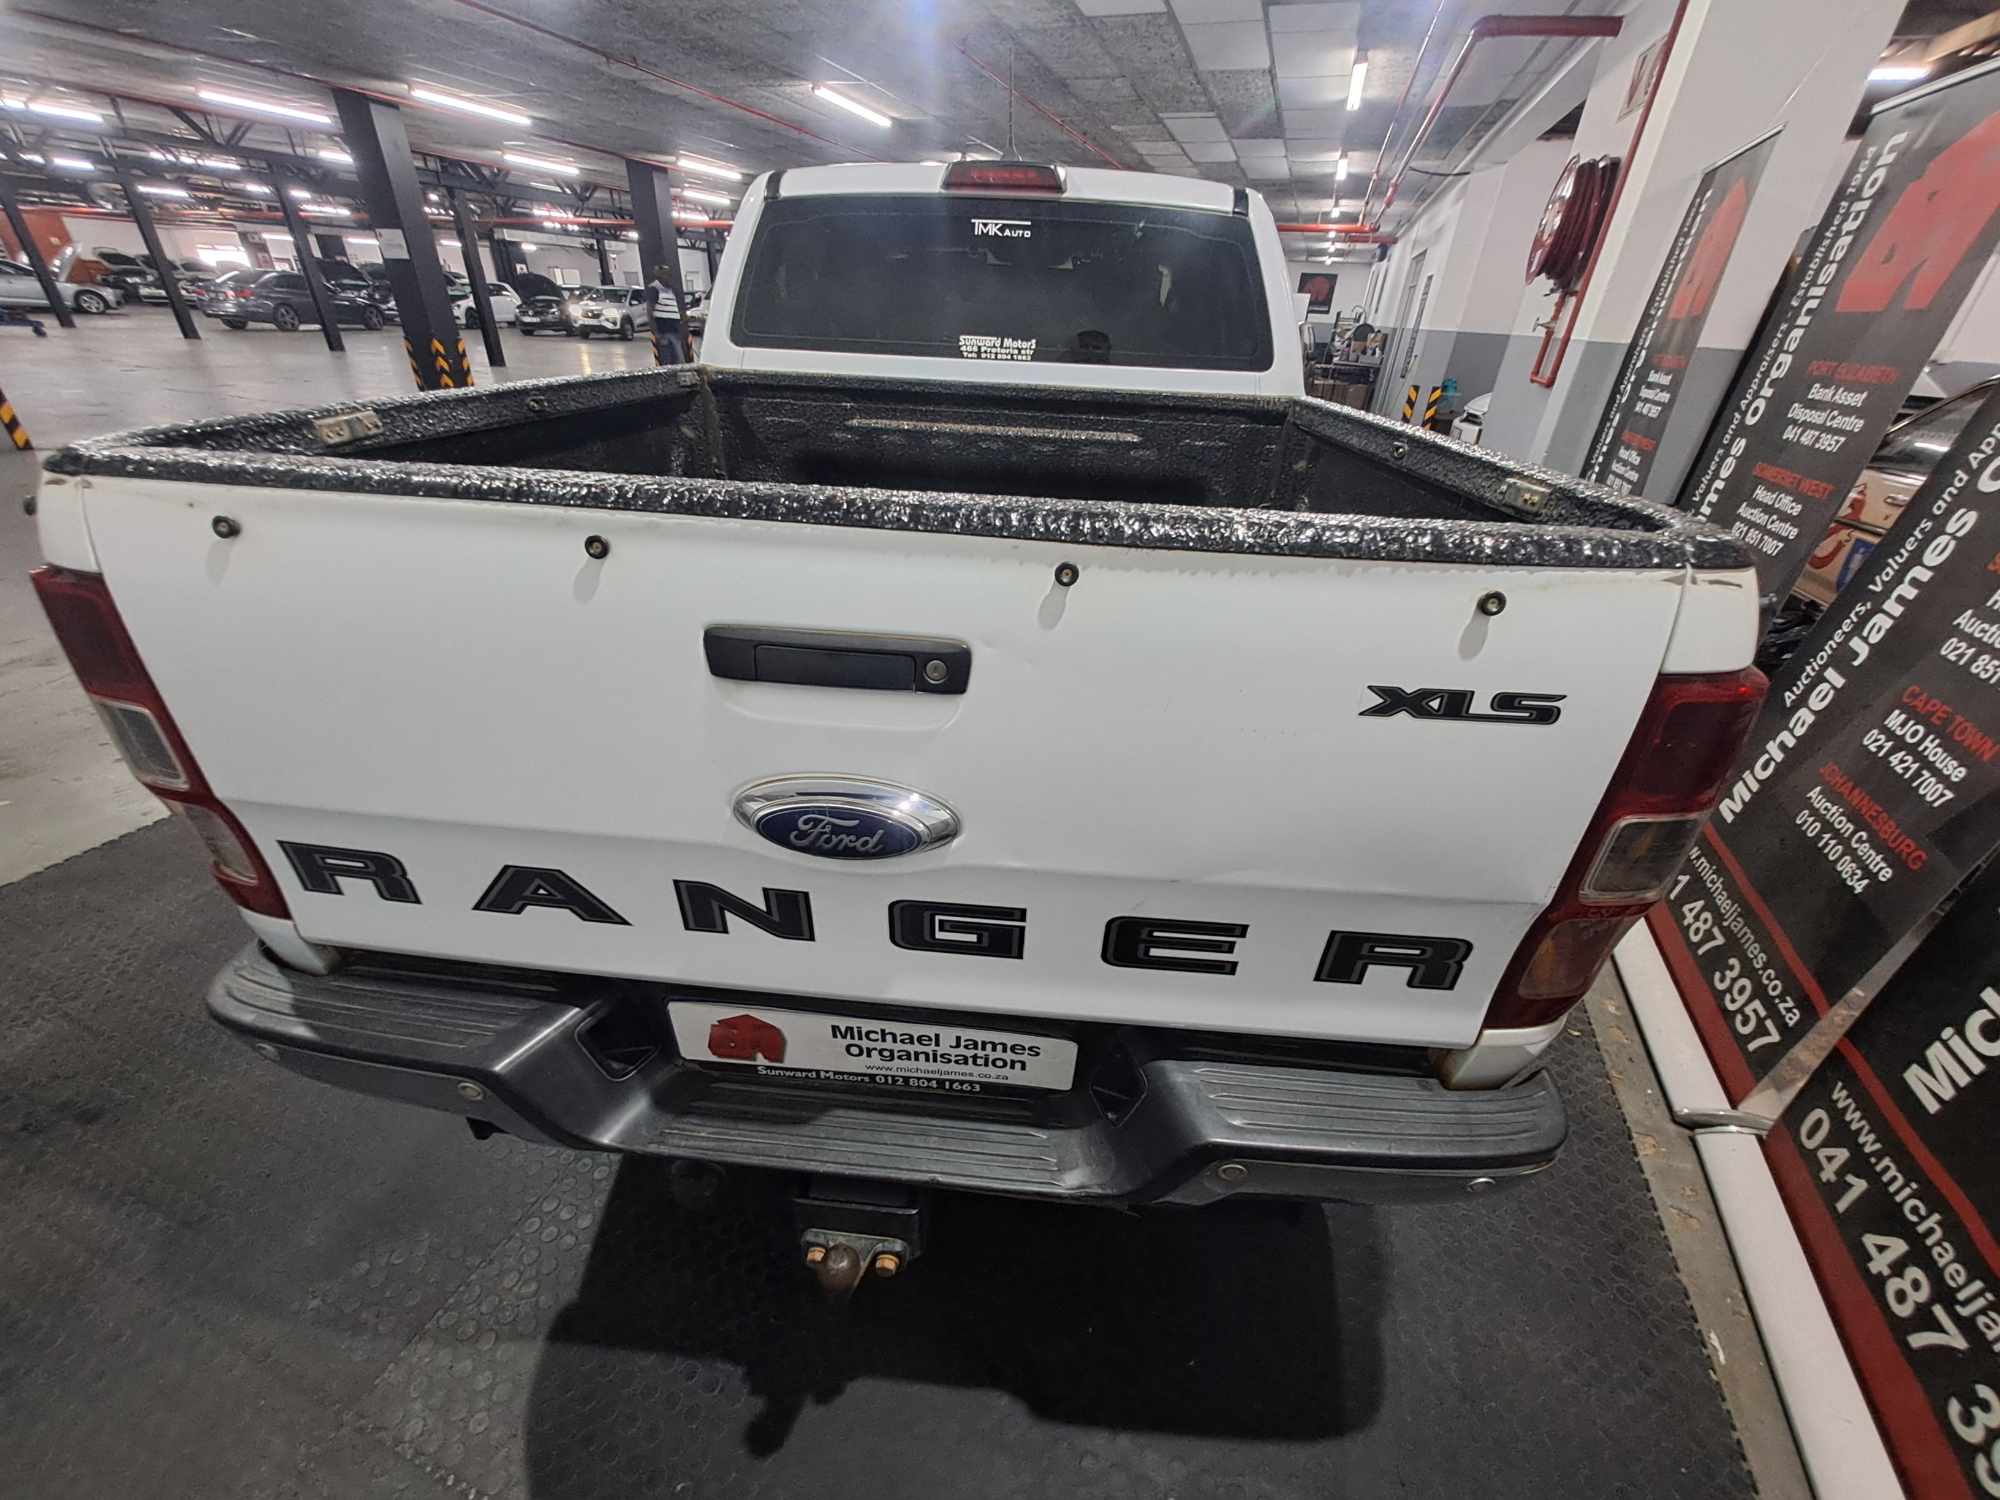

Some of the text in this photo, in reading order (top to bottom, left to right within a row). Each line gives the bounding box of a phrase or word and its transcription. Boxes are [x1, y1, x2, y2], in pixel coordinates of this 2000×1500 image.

[971, 219, 1031, 238] TMK AUTO
[1745, 131, 1910, 426] Organisation
[959, 335, 1037, 349] Sunward Motors
[1692, 448, 1723, 502] Valuers
[1723, 412, 1741, 444] and
[1740, 323, 1789, 411] Appraisers
[1807, 383, 1868, 408] Bank Asset
[1787, 402, 1864, 433] Disposal Centre
[1814, 432, 1847, 453] 3957
[1736, 502, 1800, 539] Auction Centre
[1752, 485, 1803, 516] Head Office
[1758, 535, 1784, 557] 7007
[1783, 600, 1872, 707] Auctioneers,
[1868, 518, 1933, 593] Valuers
[1932, 469, 1970, 515] and
[1718, 508, 1979, 824] Michael James
[1940, 637, 1976, 666] 021
[1358, 685, 1568, 726] XLS
[1903, 684, 2000, 762] CAPE TOWN
[1883, 709, 1968, 782] MJO House
[1862, 728, 1955, 808] 021 421 7007
[790, 814, 884, 851] Ford
[1806, 786, 1893, 882] Auction Centre
[1818, 761, 1928, 871] JOHANNESBURG
[1795, 809, 1870, 894] 010 110 0634
[277, 839, 1474, 990] RANGER
[1681, 899, 1726, 956] 487
[1714, 958, 1781, 1052] 3957
[831, 1024, 1041, 1058] Michael James
[845, 1043, 1027, 1072] Organisation
[757, 1065, 981, 1093] Sunward Motors 012 804 1663
[865, 1063, 1009, 1081] www.michaeljames.co.za
[1800, 1108, 1869, 1215] 041
[1861, 1232, 1972, 1352] 487
[1831, 1081, 2000, 1352] www.michaelja
